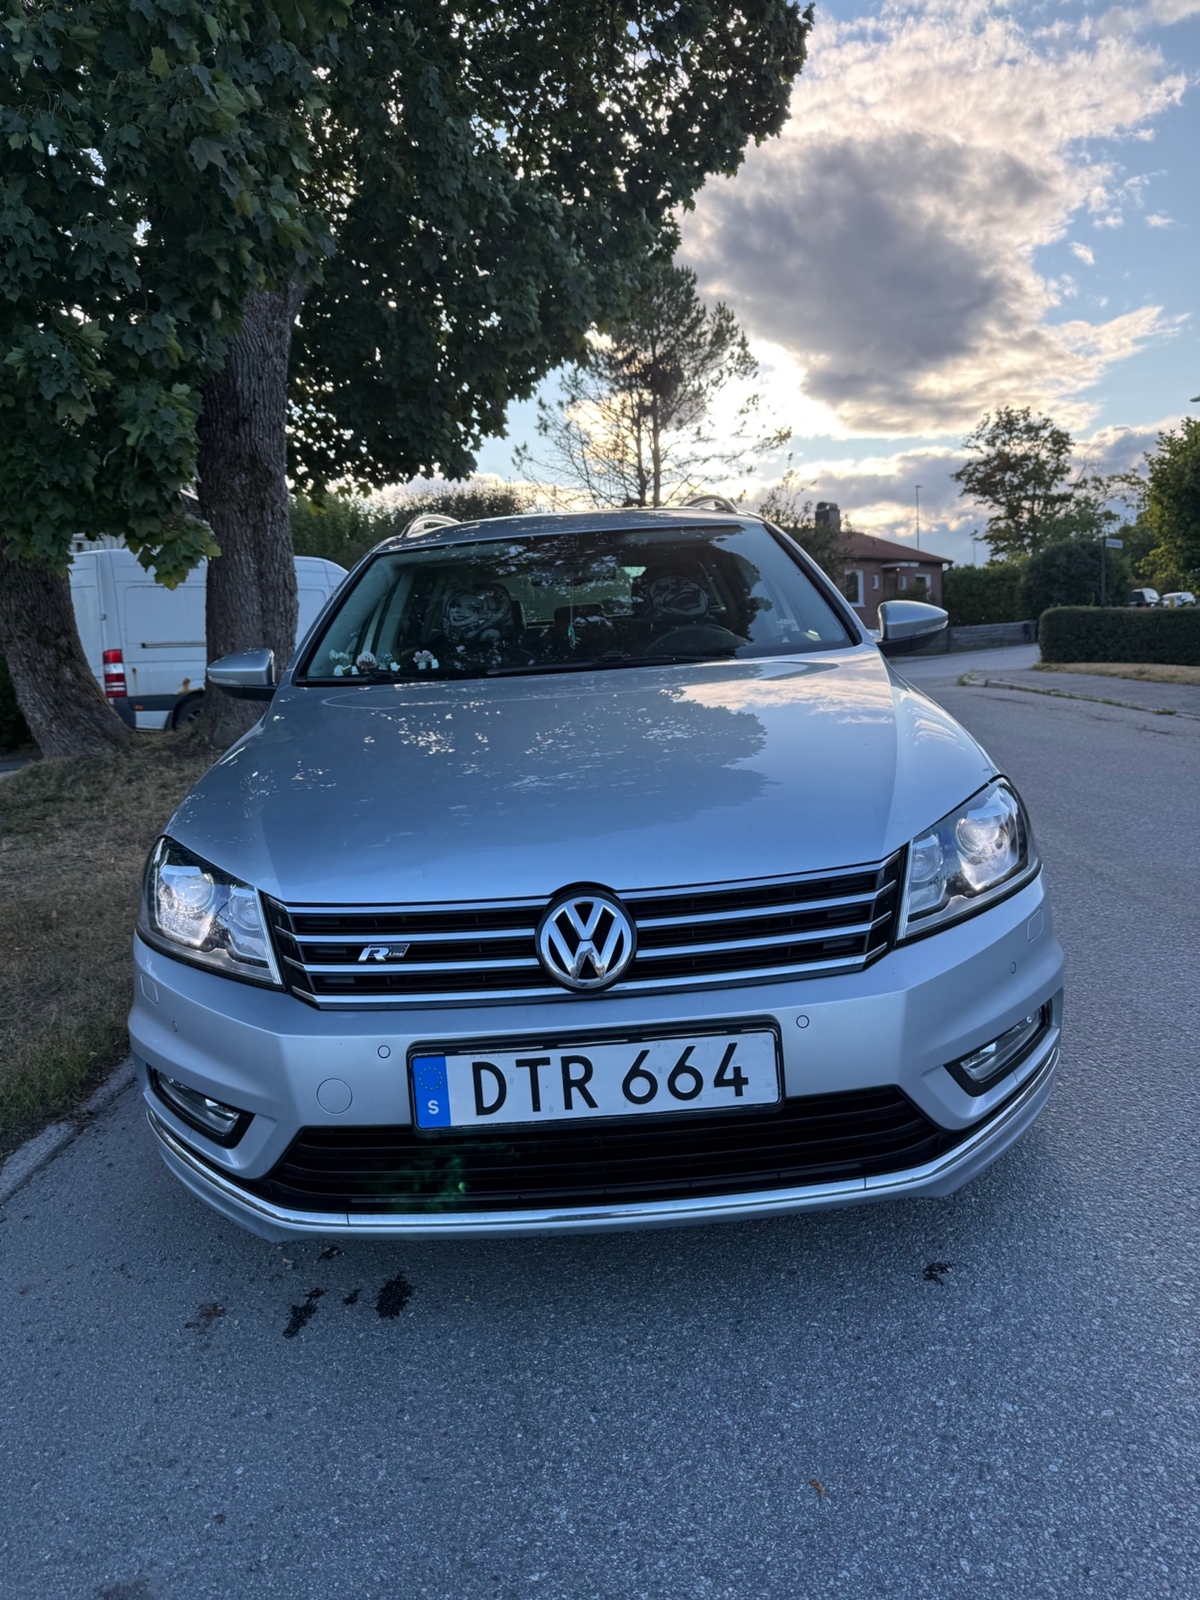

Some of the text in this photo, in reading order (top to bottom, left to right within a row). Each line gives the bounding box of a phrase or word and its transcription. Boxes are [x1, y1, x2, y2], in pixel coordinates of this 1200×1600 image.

[358, 947, 389, 961] R
[542, 897, 632, 988] VW
[472, 1042, 749, 1116] DTR 664
[427, 1100, 440, 1115] S
